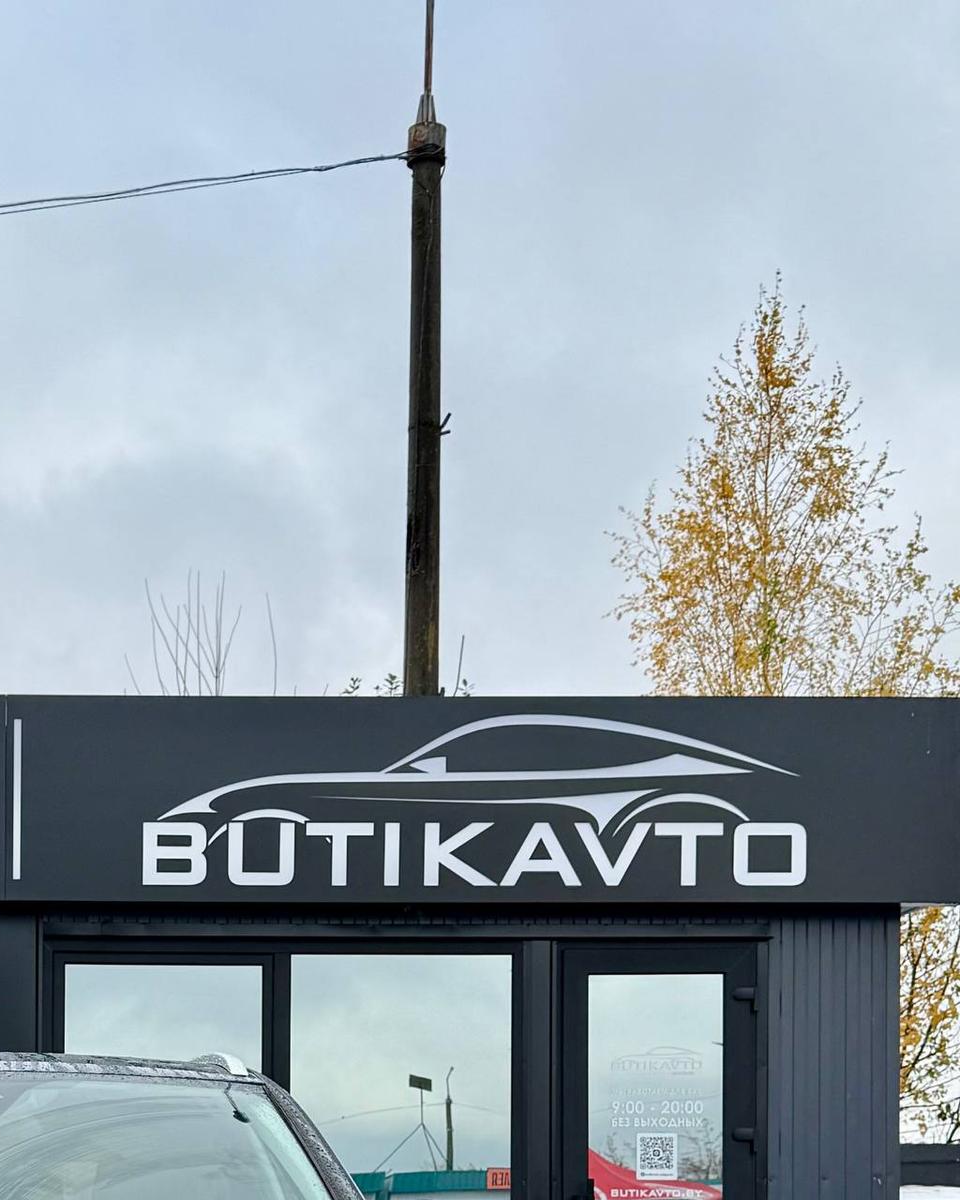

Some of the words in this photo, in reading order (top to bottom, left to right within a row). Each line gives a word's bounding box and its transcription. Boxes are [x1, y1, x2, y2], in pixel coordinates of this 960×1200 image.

[142, 820, 808, 887] BUTIKAVTO
[612, 1100, 644, 1114] 9:00
[661, 1100, 704, 1114] 20:00
[611, 1117, 630, 1127] БЕЗ
[633, 1117, 704, 1128] ВЫХОДНЫХ
[610, 1188, 703, 1198] BUTIKAVTO.BY
